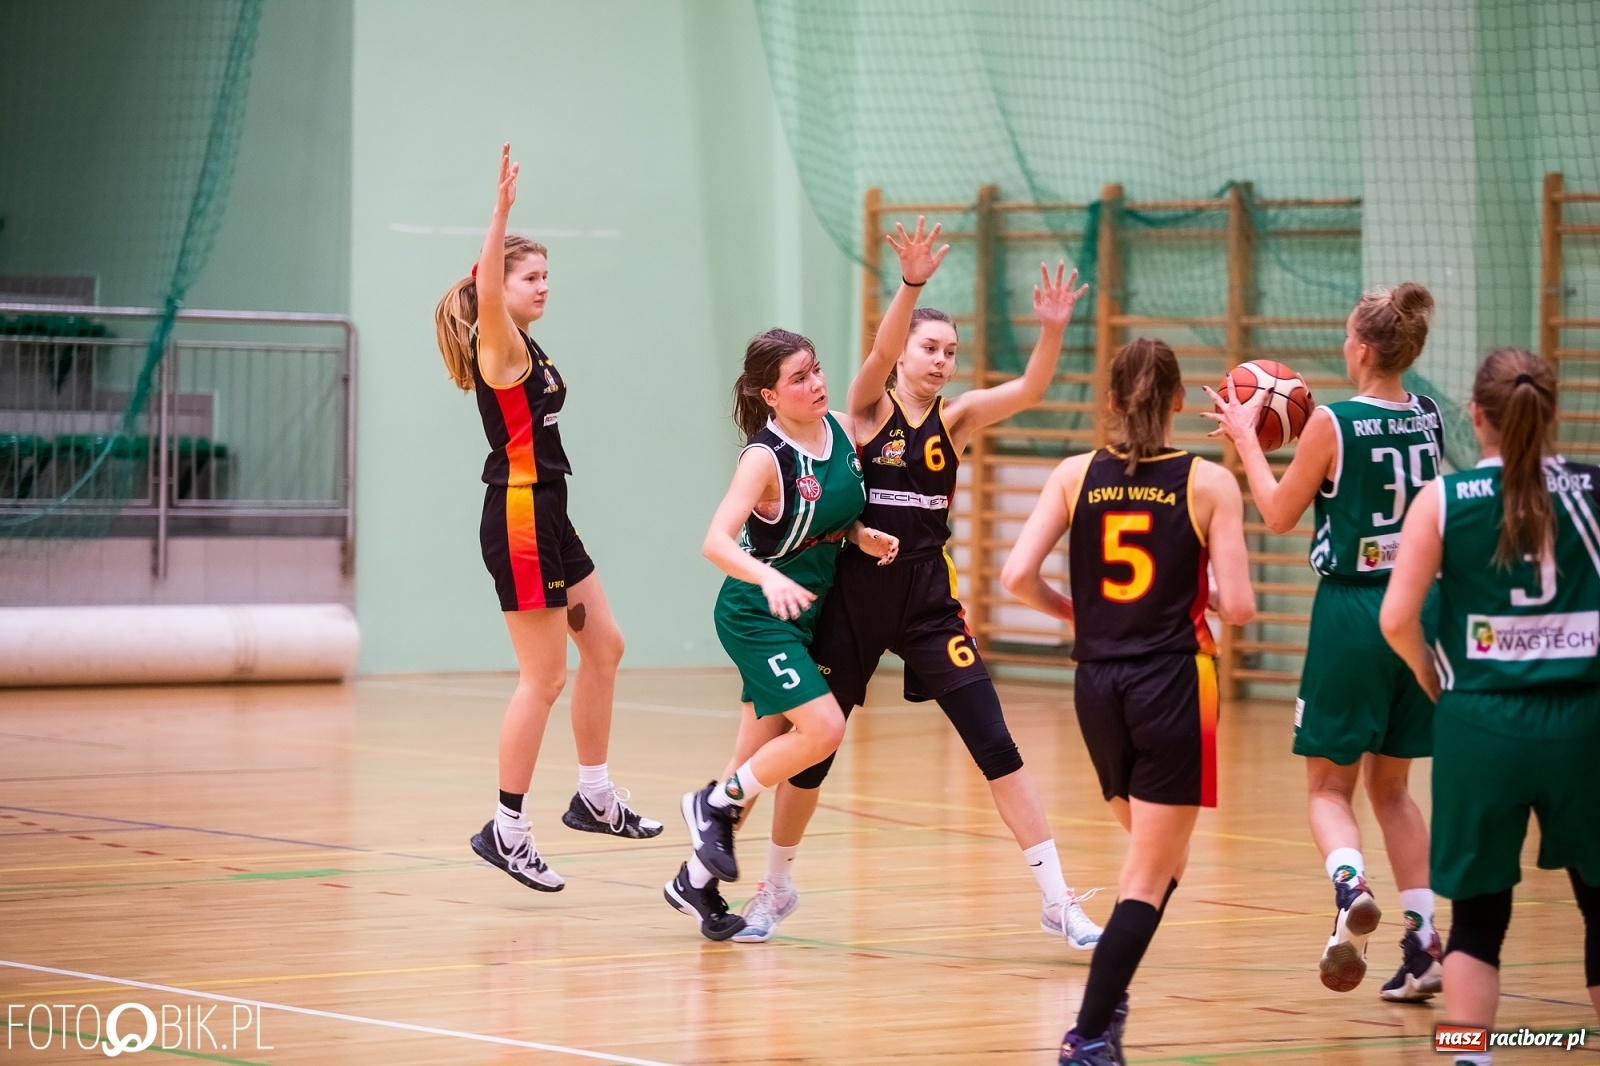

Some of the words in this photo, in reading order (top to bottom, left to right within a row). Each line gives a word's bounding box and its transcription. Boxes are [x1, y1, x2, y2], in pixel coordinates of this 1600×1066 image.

[1352, 418, 1384, 437] RKK
[924, 434, 946, 472] 6
[1088, 486, 1124, 504] ISWJ
[1127, 486, 1177, 507] WISŁA
[1456, 478, 1495, 499] RKK
[1101, 510, 1156, 604] 5
[947, 634, 976, 668] 6
[1497, 631, 1595, 652] WAGTECH
[767, 652, 801, 690] 5
